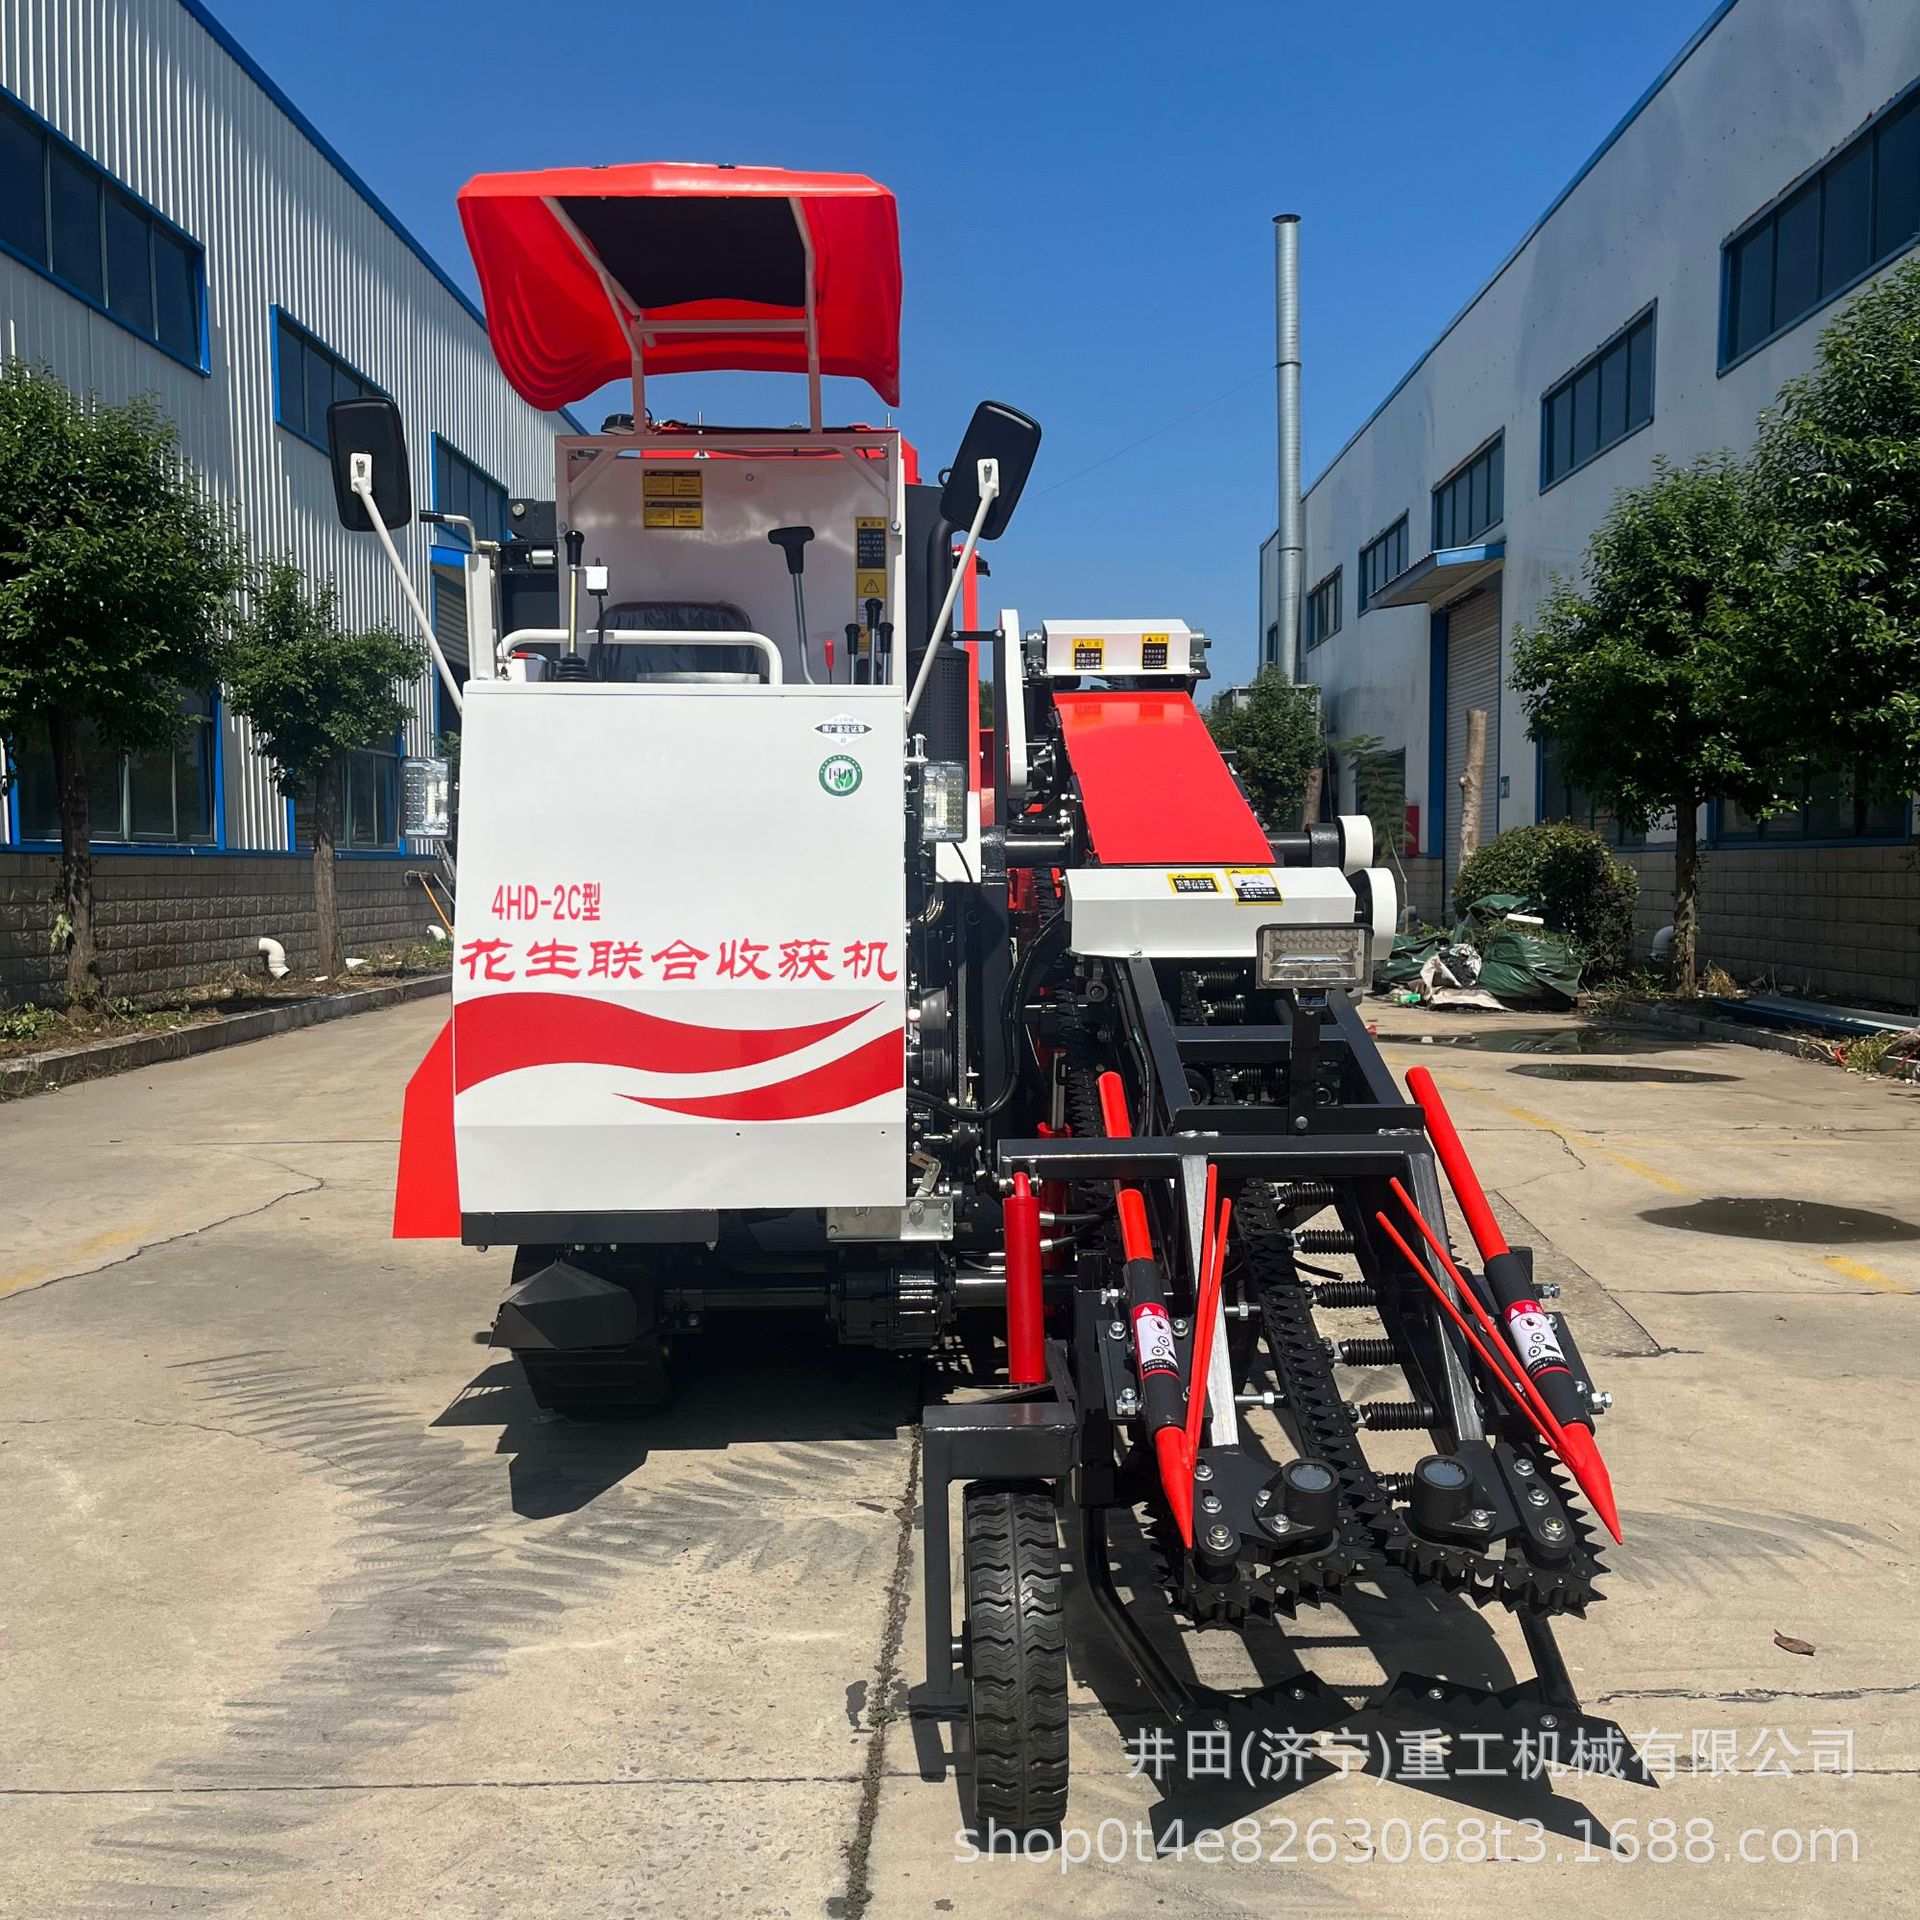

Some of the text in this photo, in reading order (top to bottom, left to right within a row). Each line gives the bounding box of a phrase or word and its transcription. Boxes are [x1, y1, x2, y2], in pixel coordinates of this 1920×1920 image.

[491, 882, 601, 921] 4HD-2C型
[459, 937, 899, 982] 花生联合收获机
